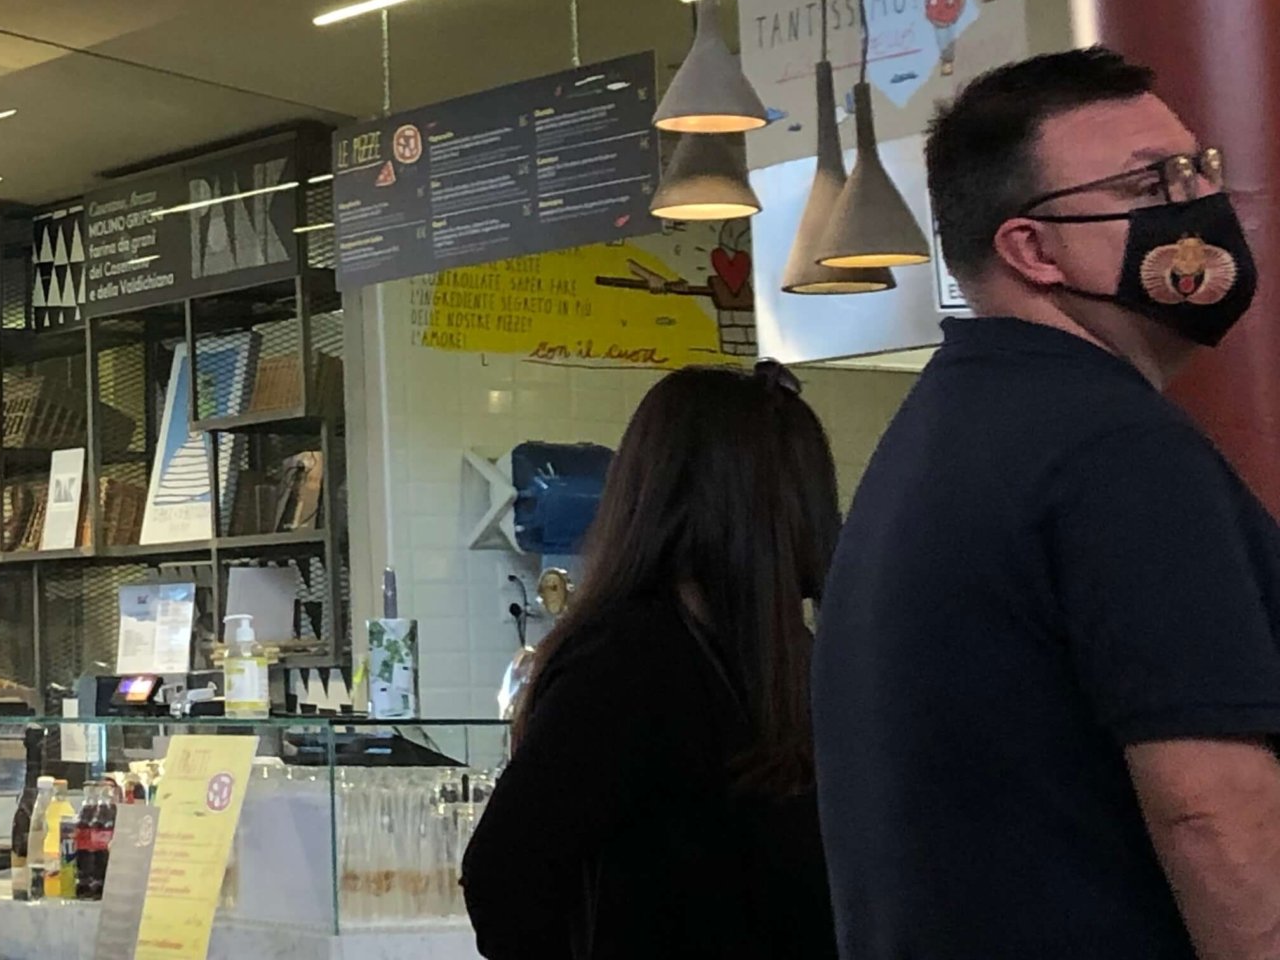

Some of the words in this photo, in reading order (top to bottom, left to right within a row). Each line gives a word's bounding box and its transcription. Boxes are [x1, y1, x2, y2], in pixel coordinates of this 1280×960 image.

[352, 130, 383, 164] PIZZE
[88, 216, 125, 239] MOLINO
[88, 241, 117, 260] farina
[131, 228, 157, 254] grani
[120, 272, 175, 296] Valdichiana
[501, 293, 553, 314] SEGRETO
[447, 311, 491, 331] NOSTRE
[529, 340, 570, 360] con
